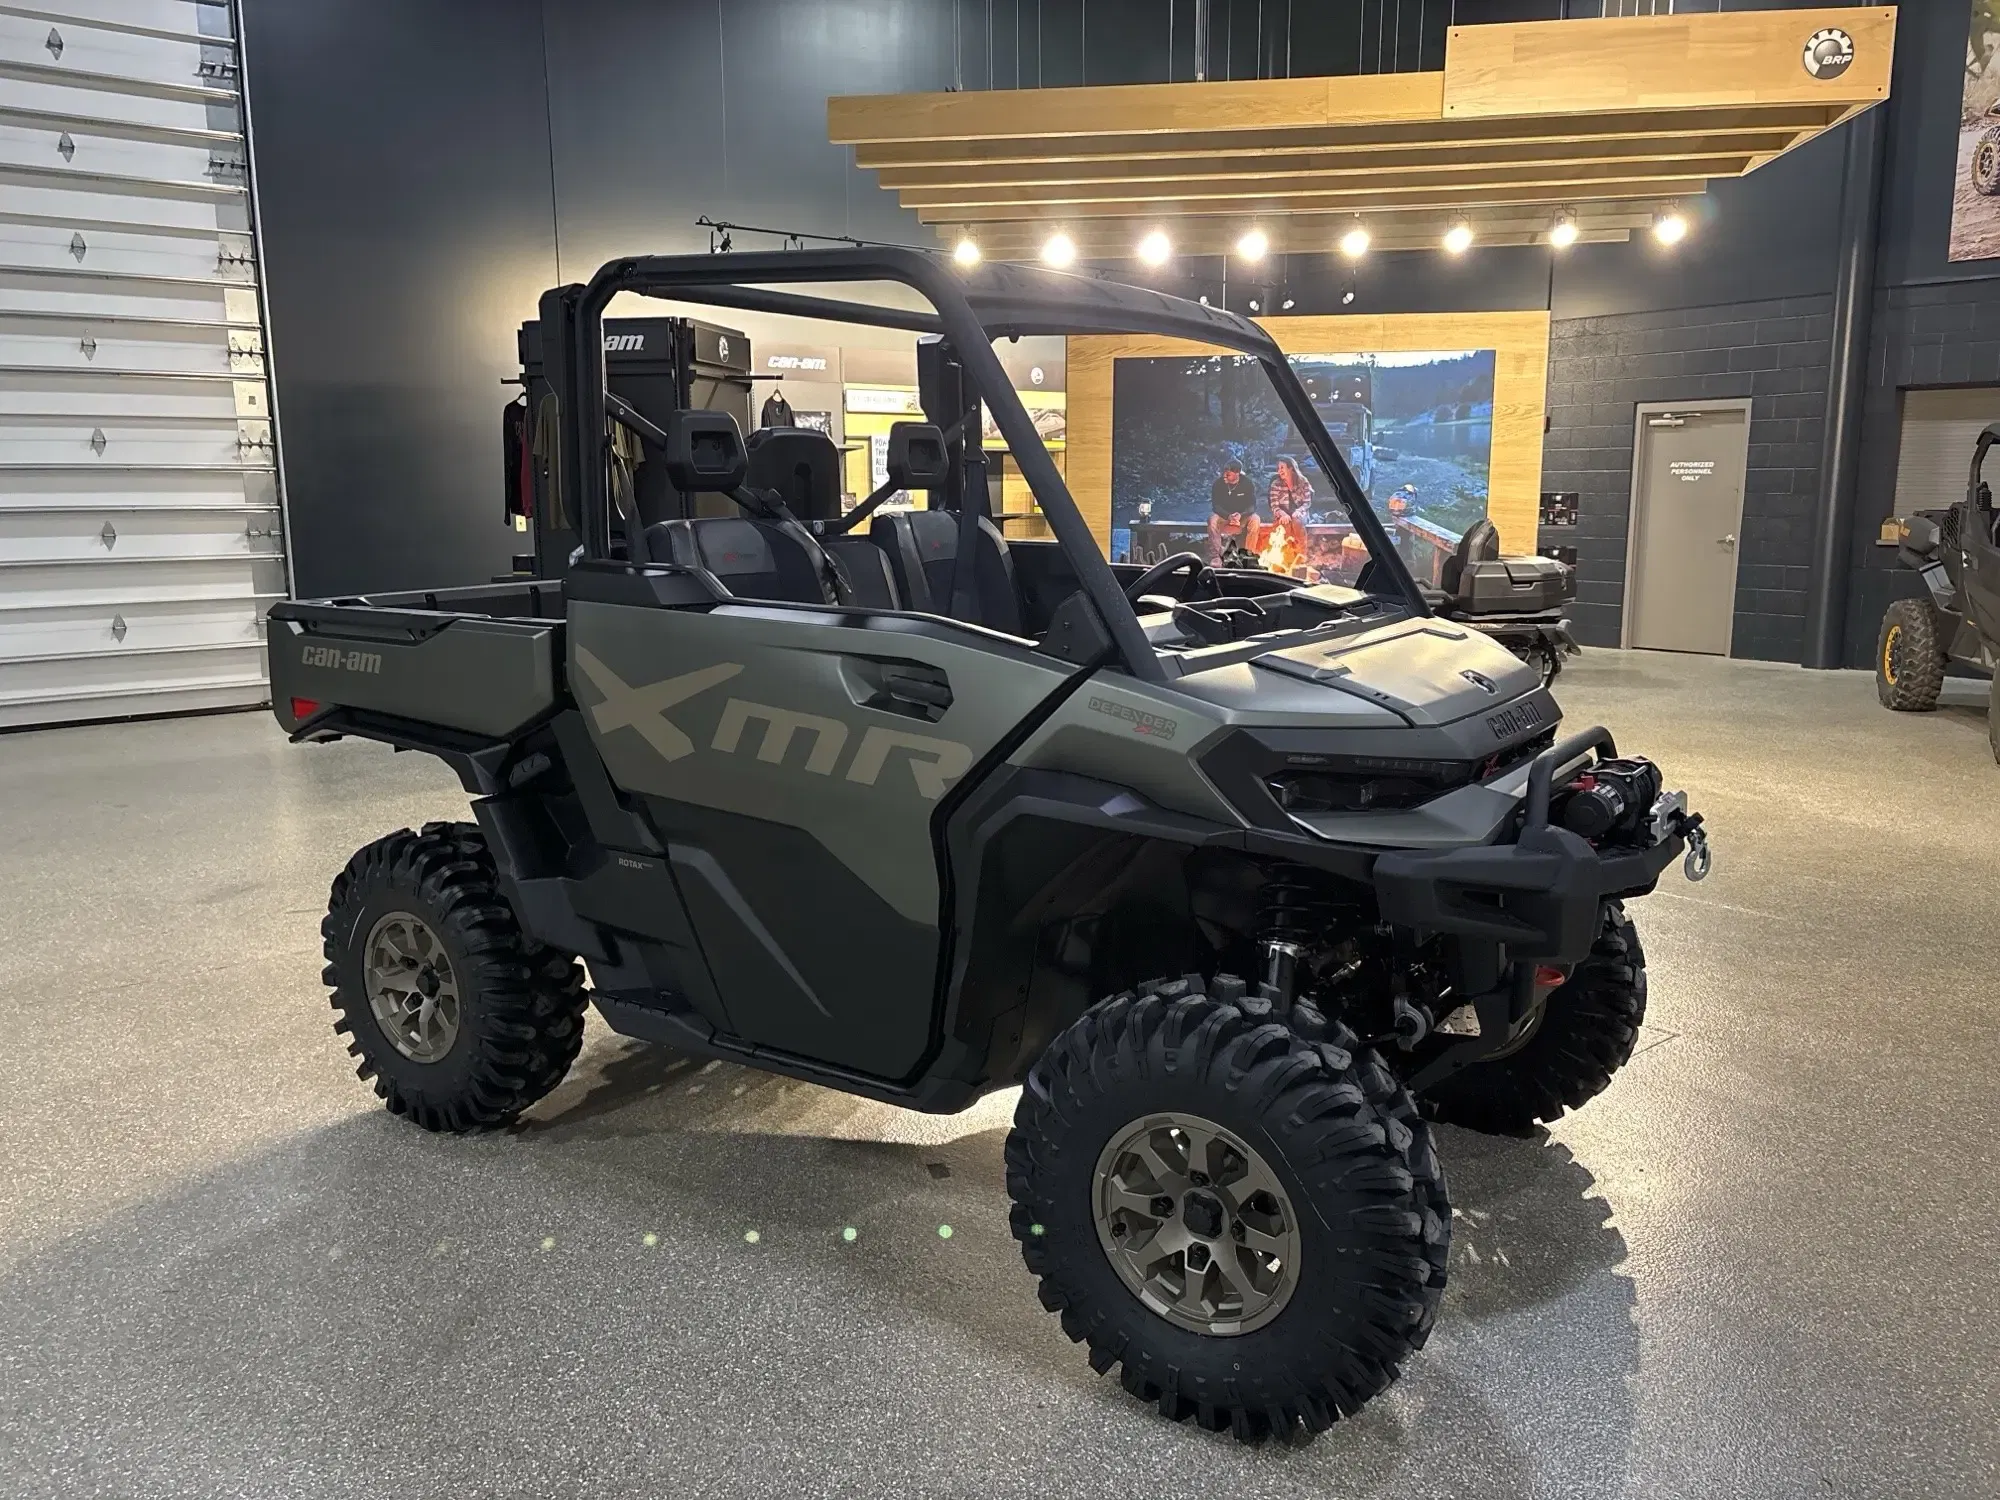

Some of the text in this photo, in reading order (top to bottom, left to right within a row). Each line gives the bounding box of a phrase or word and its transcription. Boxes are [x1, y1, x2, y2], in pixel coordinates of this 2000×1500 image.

[1822, 55, 1852, 65] BRP
[302, 645, 382, 674] can-am
[1088, 696, 1177, 732] DEFENDER
[618, 857, 644, 870] ROTAX
